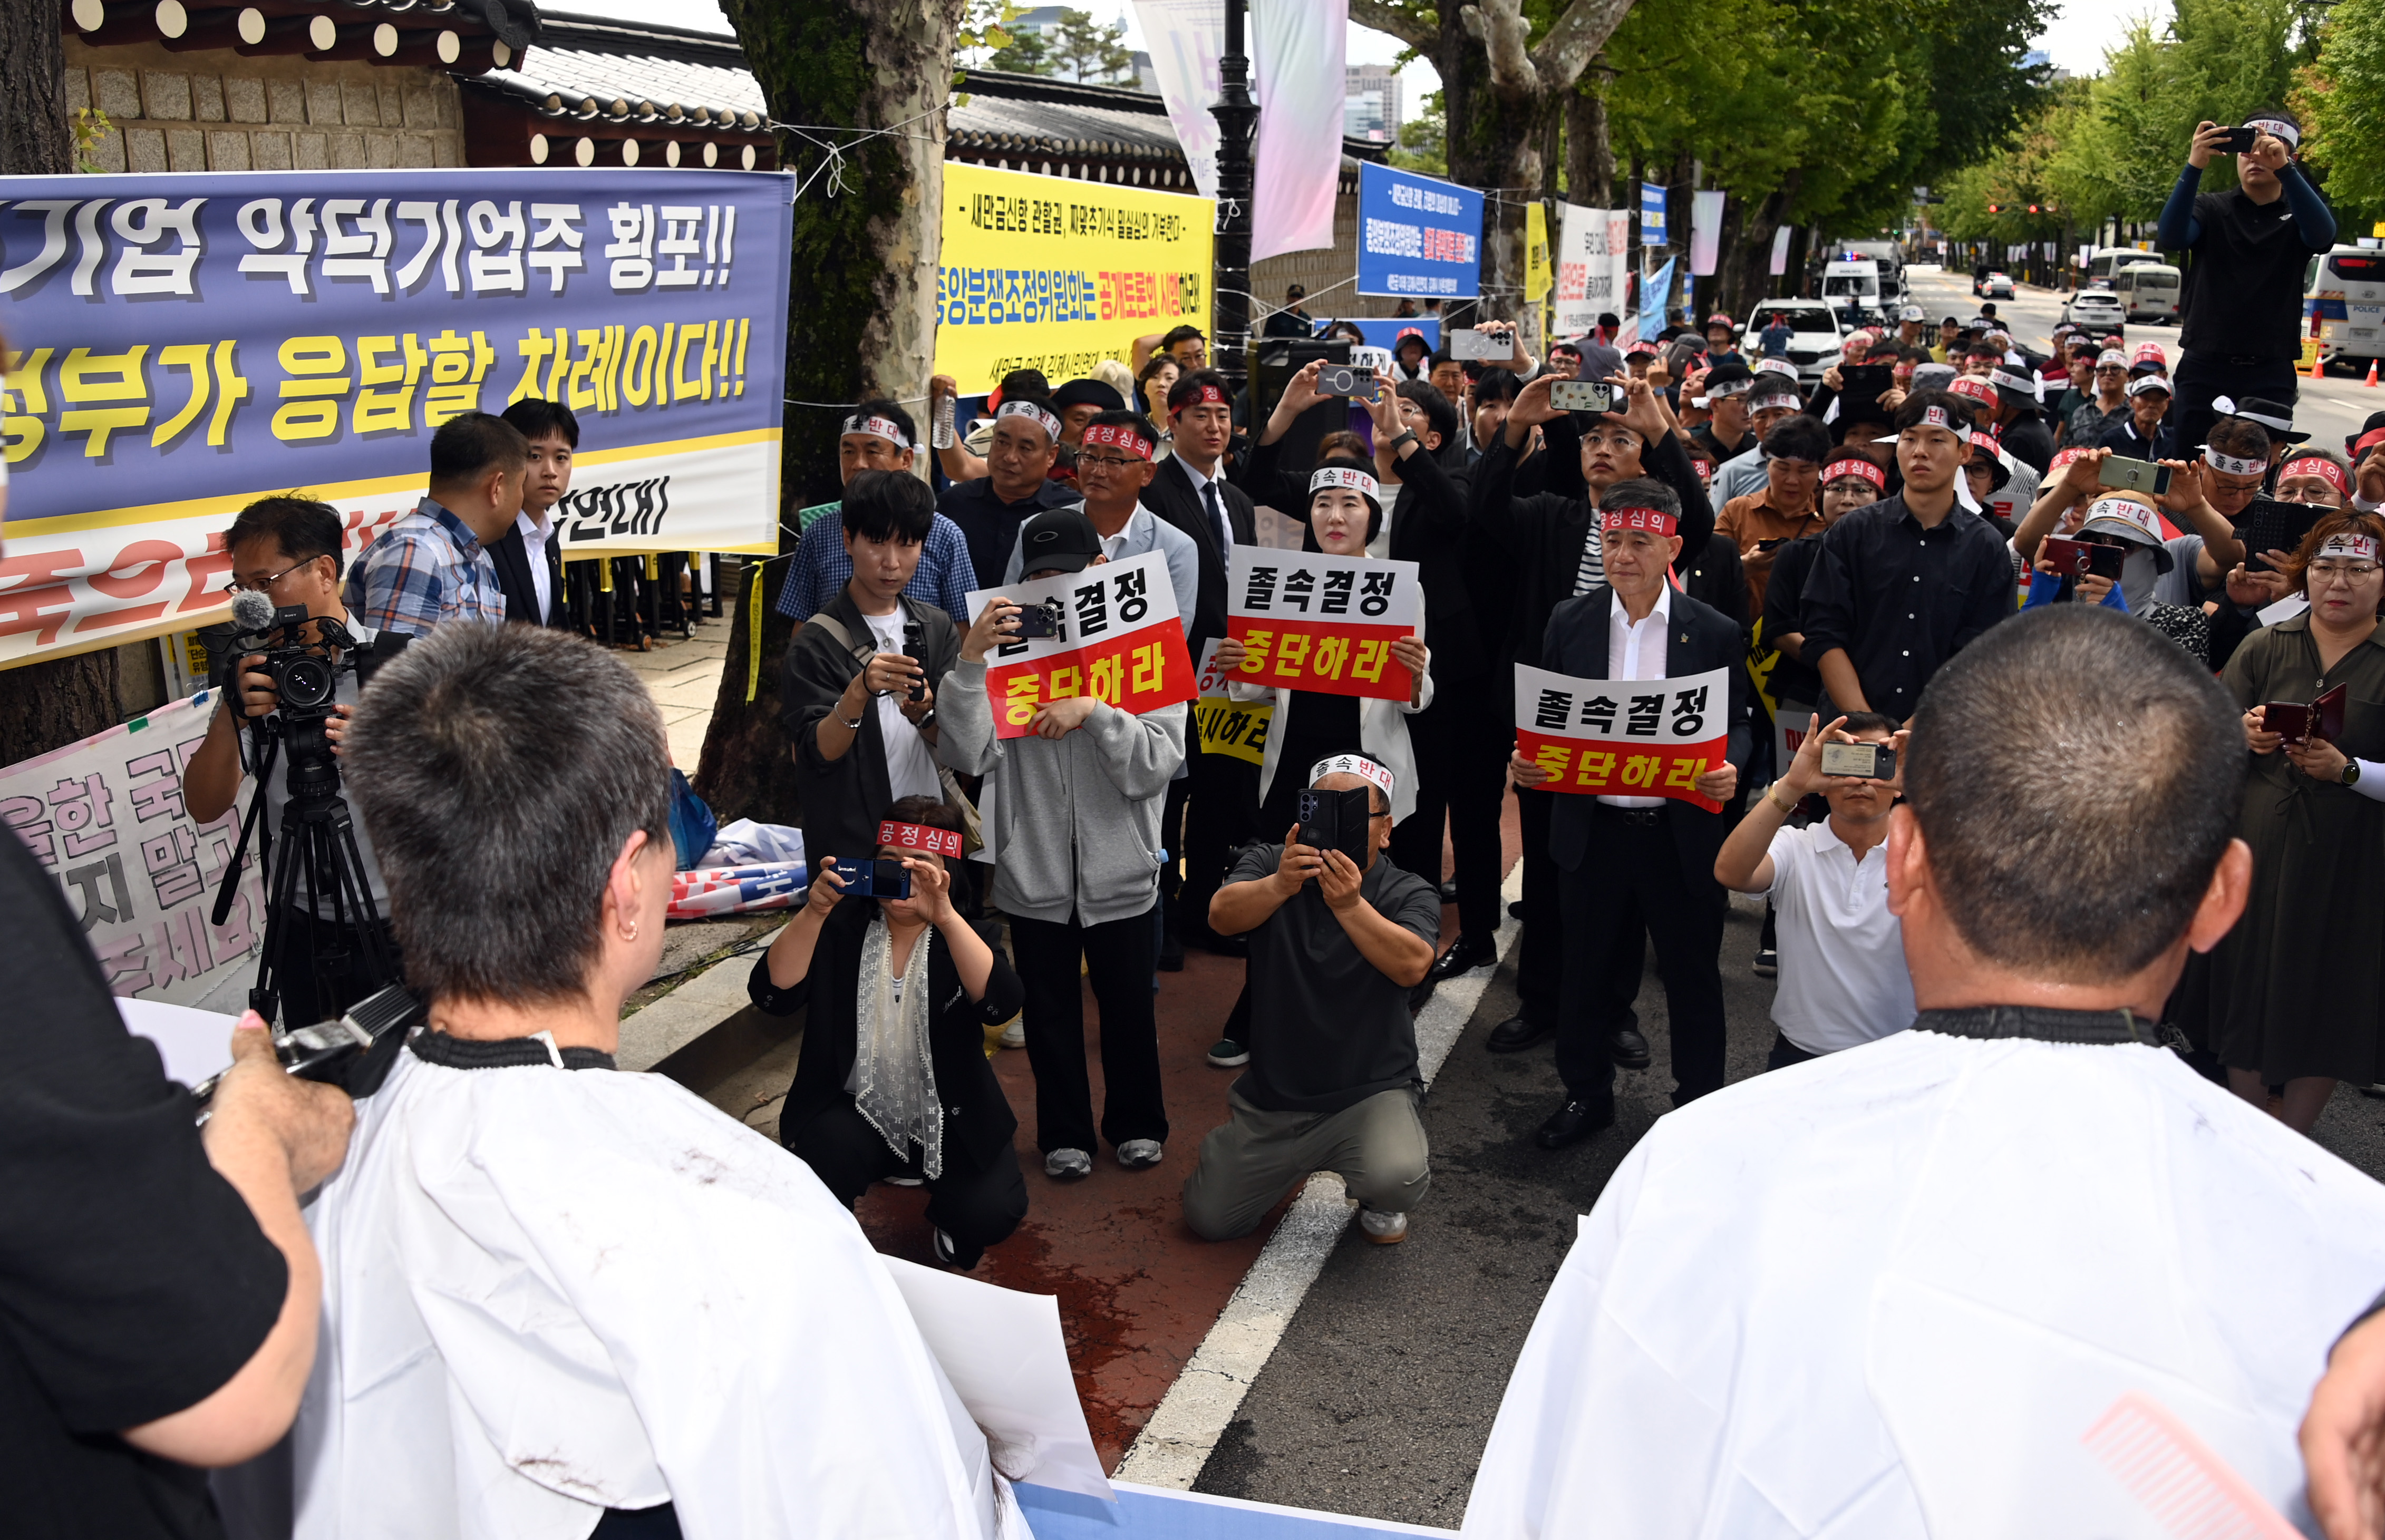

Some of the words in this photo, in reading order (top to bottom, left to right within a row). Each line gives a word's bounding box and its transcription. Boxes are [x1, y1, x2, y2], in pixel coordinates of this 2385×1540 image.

[971, 193, 1027, 232] 새만금신항
[1032, 200, 1065, 239] 관할권,
[1070, 204, 1114, 239] 짜맞추기식
[1152, 213, 1180, 242] 거부한다
[0, 198, 209, 295] 기업
[237, 198, 583, 294] 악덕기업주
[605, 202, 735, 289] 횡포!!
[1099, 271, 1159, 320] 공개토론회
[2353, 305, 2380, 314] POLICE
[271, 330, 494, 441] 응답할
[508, 318, 749, 412] 차례이다!!
[1929, 408, 1944, 424] 반
[1087, 427, 1148, 455] 공정심의
[2280, 460, 2339, 483] 정심의
[998, 568, 1148, 657] 결정
[1244, 566, 1395, 616] 졸속결정
[1239, 629, 1391, 683] 중단하라
[1006, 641, 1165, 725] 중단하라
[1535, 685, 1708, 737] 졸속결정
[1316, 757, 1391, 790] 졸속반대
[1534, 744, 1707, 791] 중단하라
[882, 823, 958, 855] 공정심의
